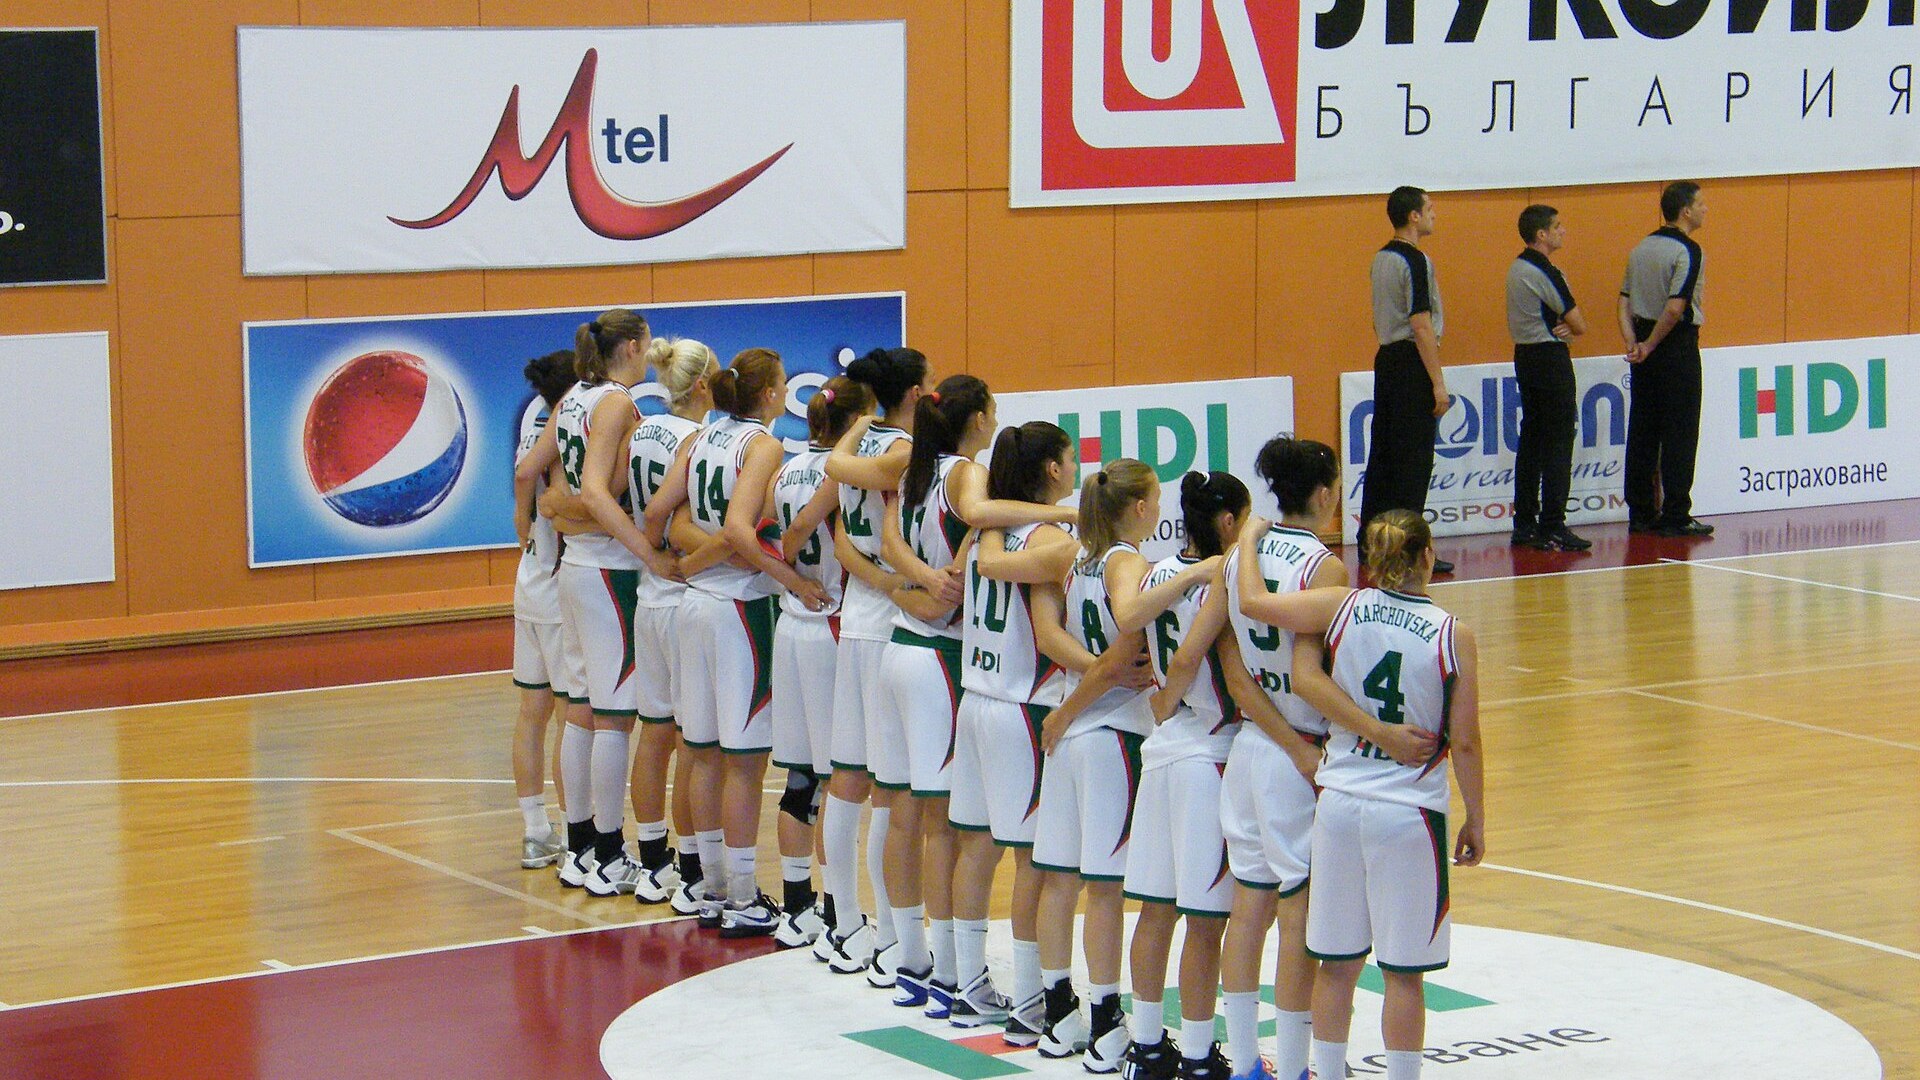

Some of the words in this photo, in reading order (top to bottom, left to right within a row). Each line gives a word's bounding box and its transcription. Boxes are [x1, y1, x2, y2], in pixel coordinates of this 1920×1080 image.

[1316, 64, 1913, 139] БЪЛГАРИЯ
[1739, 358, 1888, 440] HDI
[1057, 402, 1230, 490] HDI
[1738, 460, 1888, 497] Застраховане
[695, 459, 730, 527] 14
[1352, 603, 1439, 644] KARCHOVSKA
[971, 646, 1000, 673] HDI
[1362, 650, 1405, 725] 4
